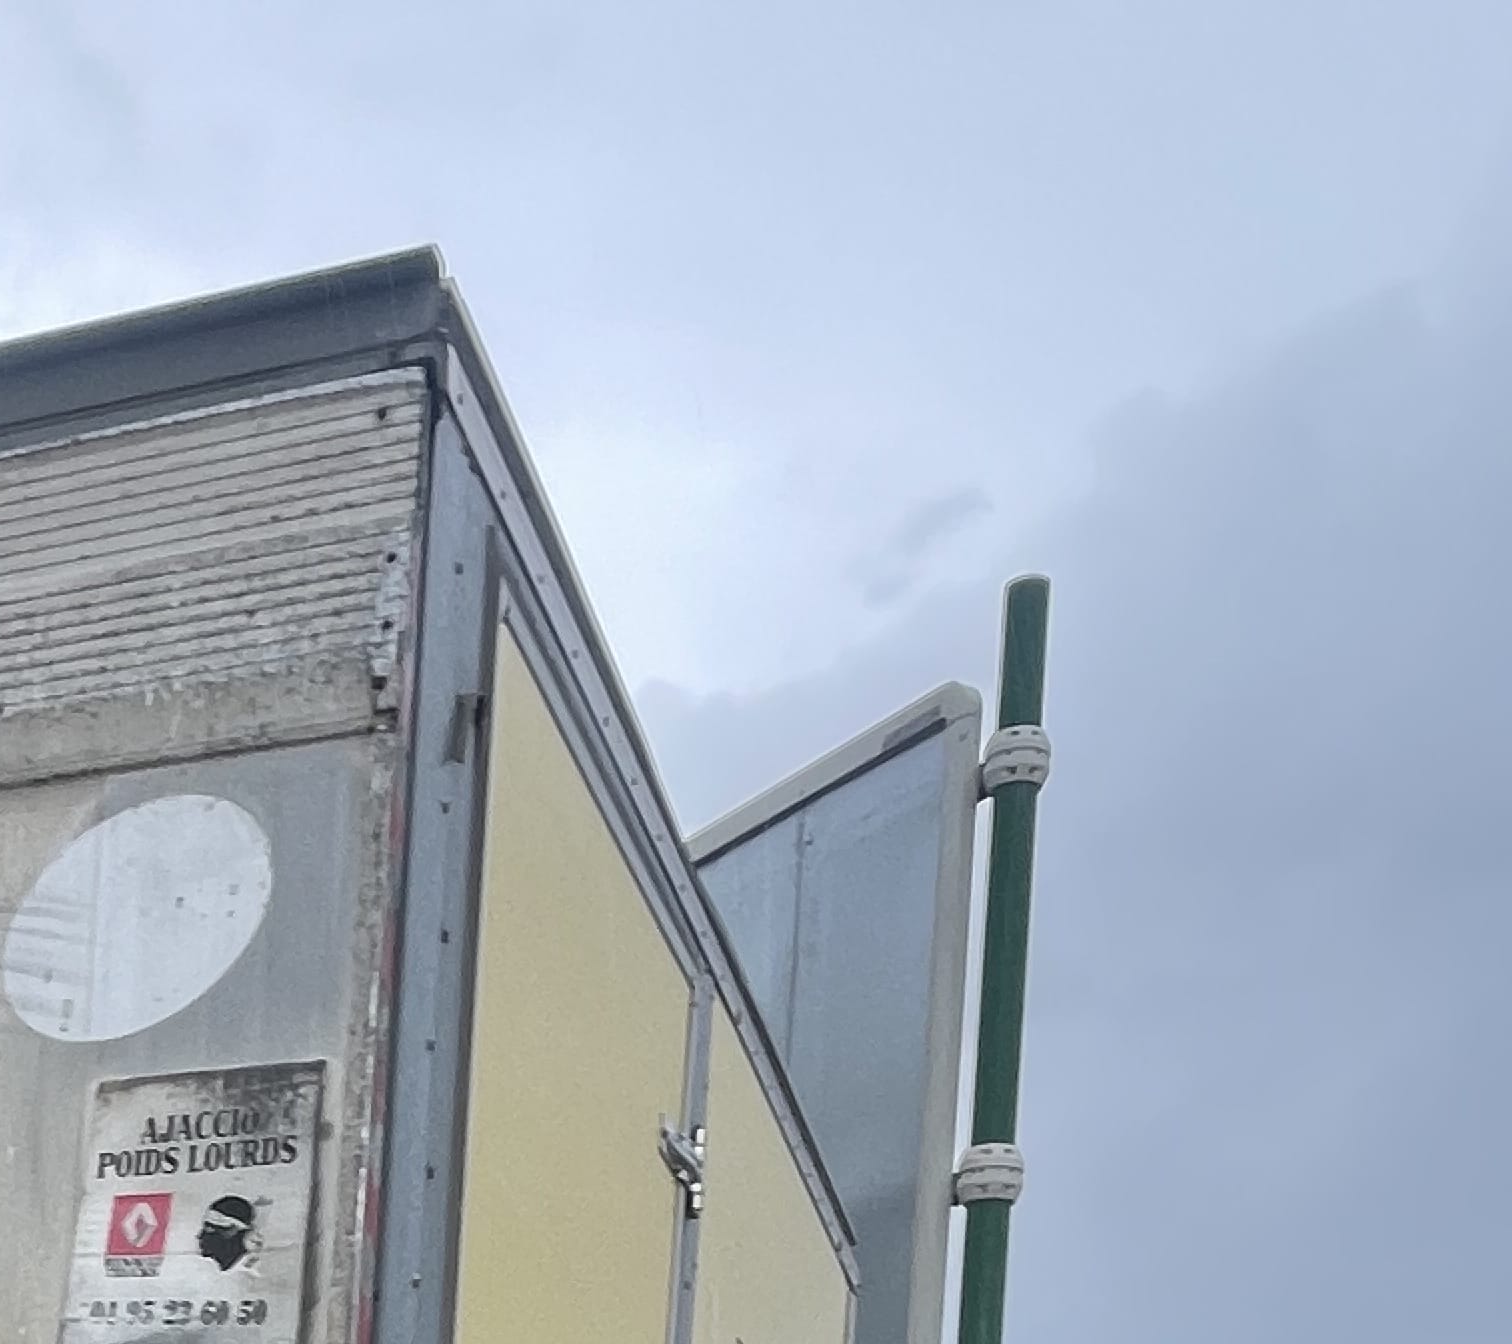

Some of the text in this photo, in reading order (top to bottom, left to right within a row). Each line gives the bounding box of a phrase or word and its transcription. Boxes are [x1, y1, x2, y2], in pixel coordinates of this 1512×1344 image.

[141, 1107, 261, 1145] AJACCIO
[96, 1135, 298, 1179] POIDS LOURDS
